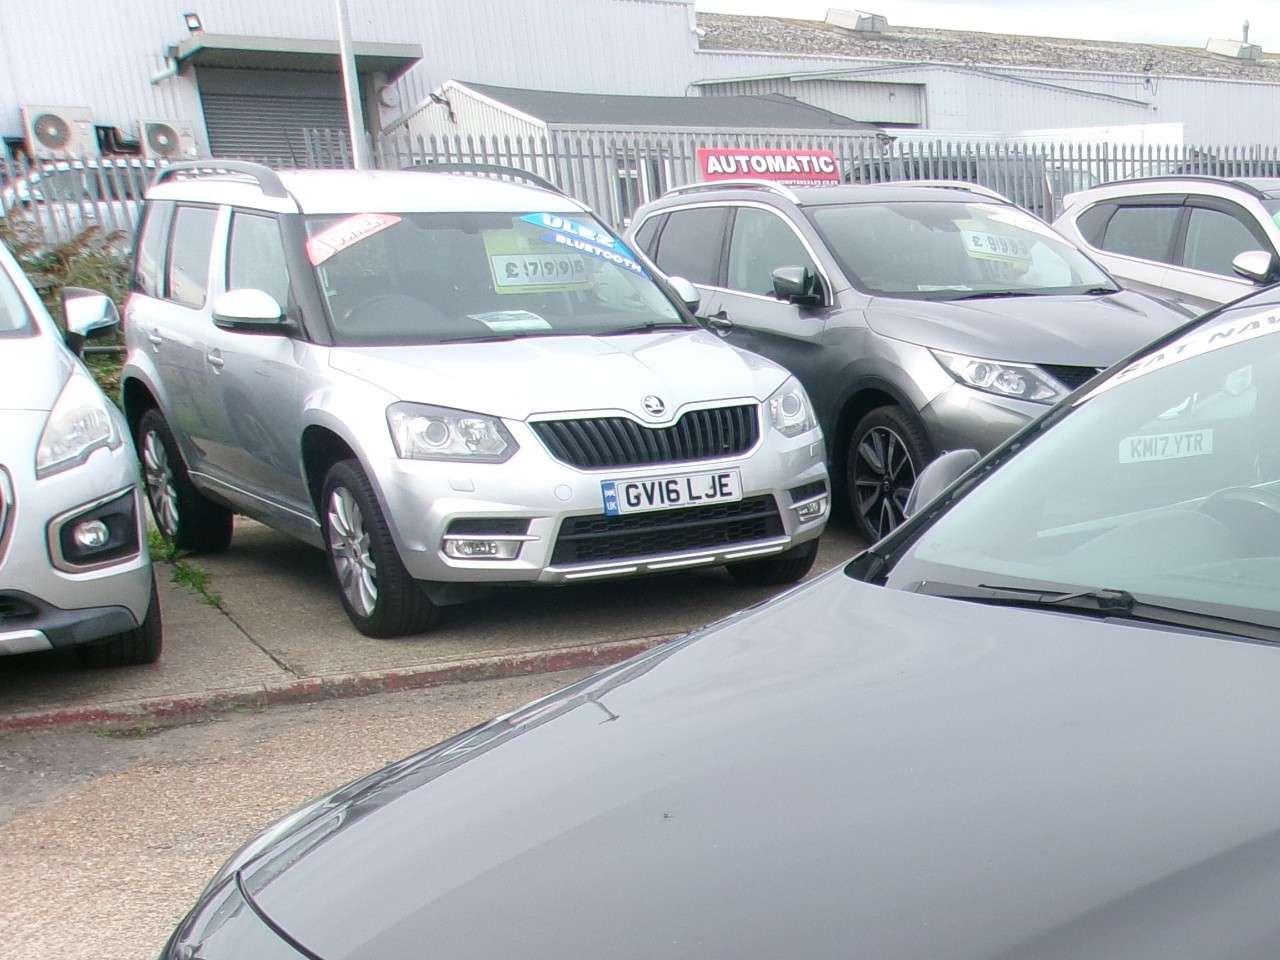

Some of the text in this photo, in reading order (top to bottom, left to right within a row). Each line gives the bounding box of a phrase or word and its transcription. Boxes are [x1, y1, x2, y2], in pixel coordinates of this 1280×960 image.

[707, 155, 834, 174] AUTOMATIC
[555, 233, 642, 273] BLUETOOTH
[1116, 344, 1191, 379] SAT
[1130, 432, 1204, 459] KM17 YTR
[625, 474, 733, 507] GV16 LJE
